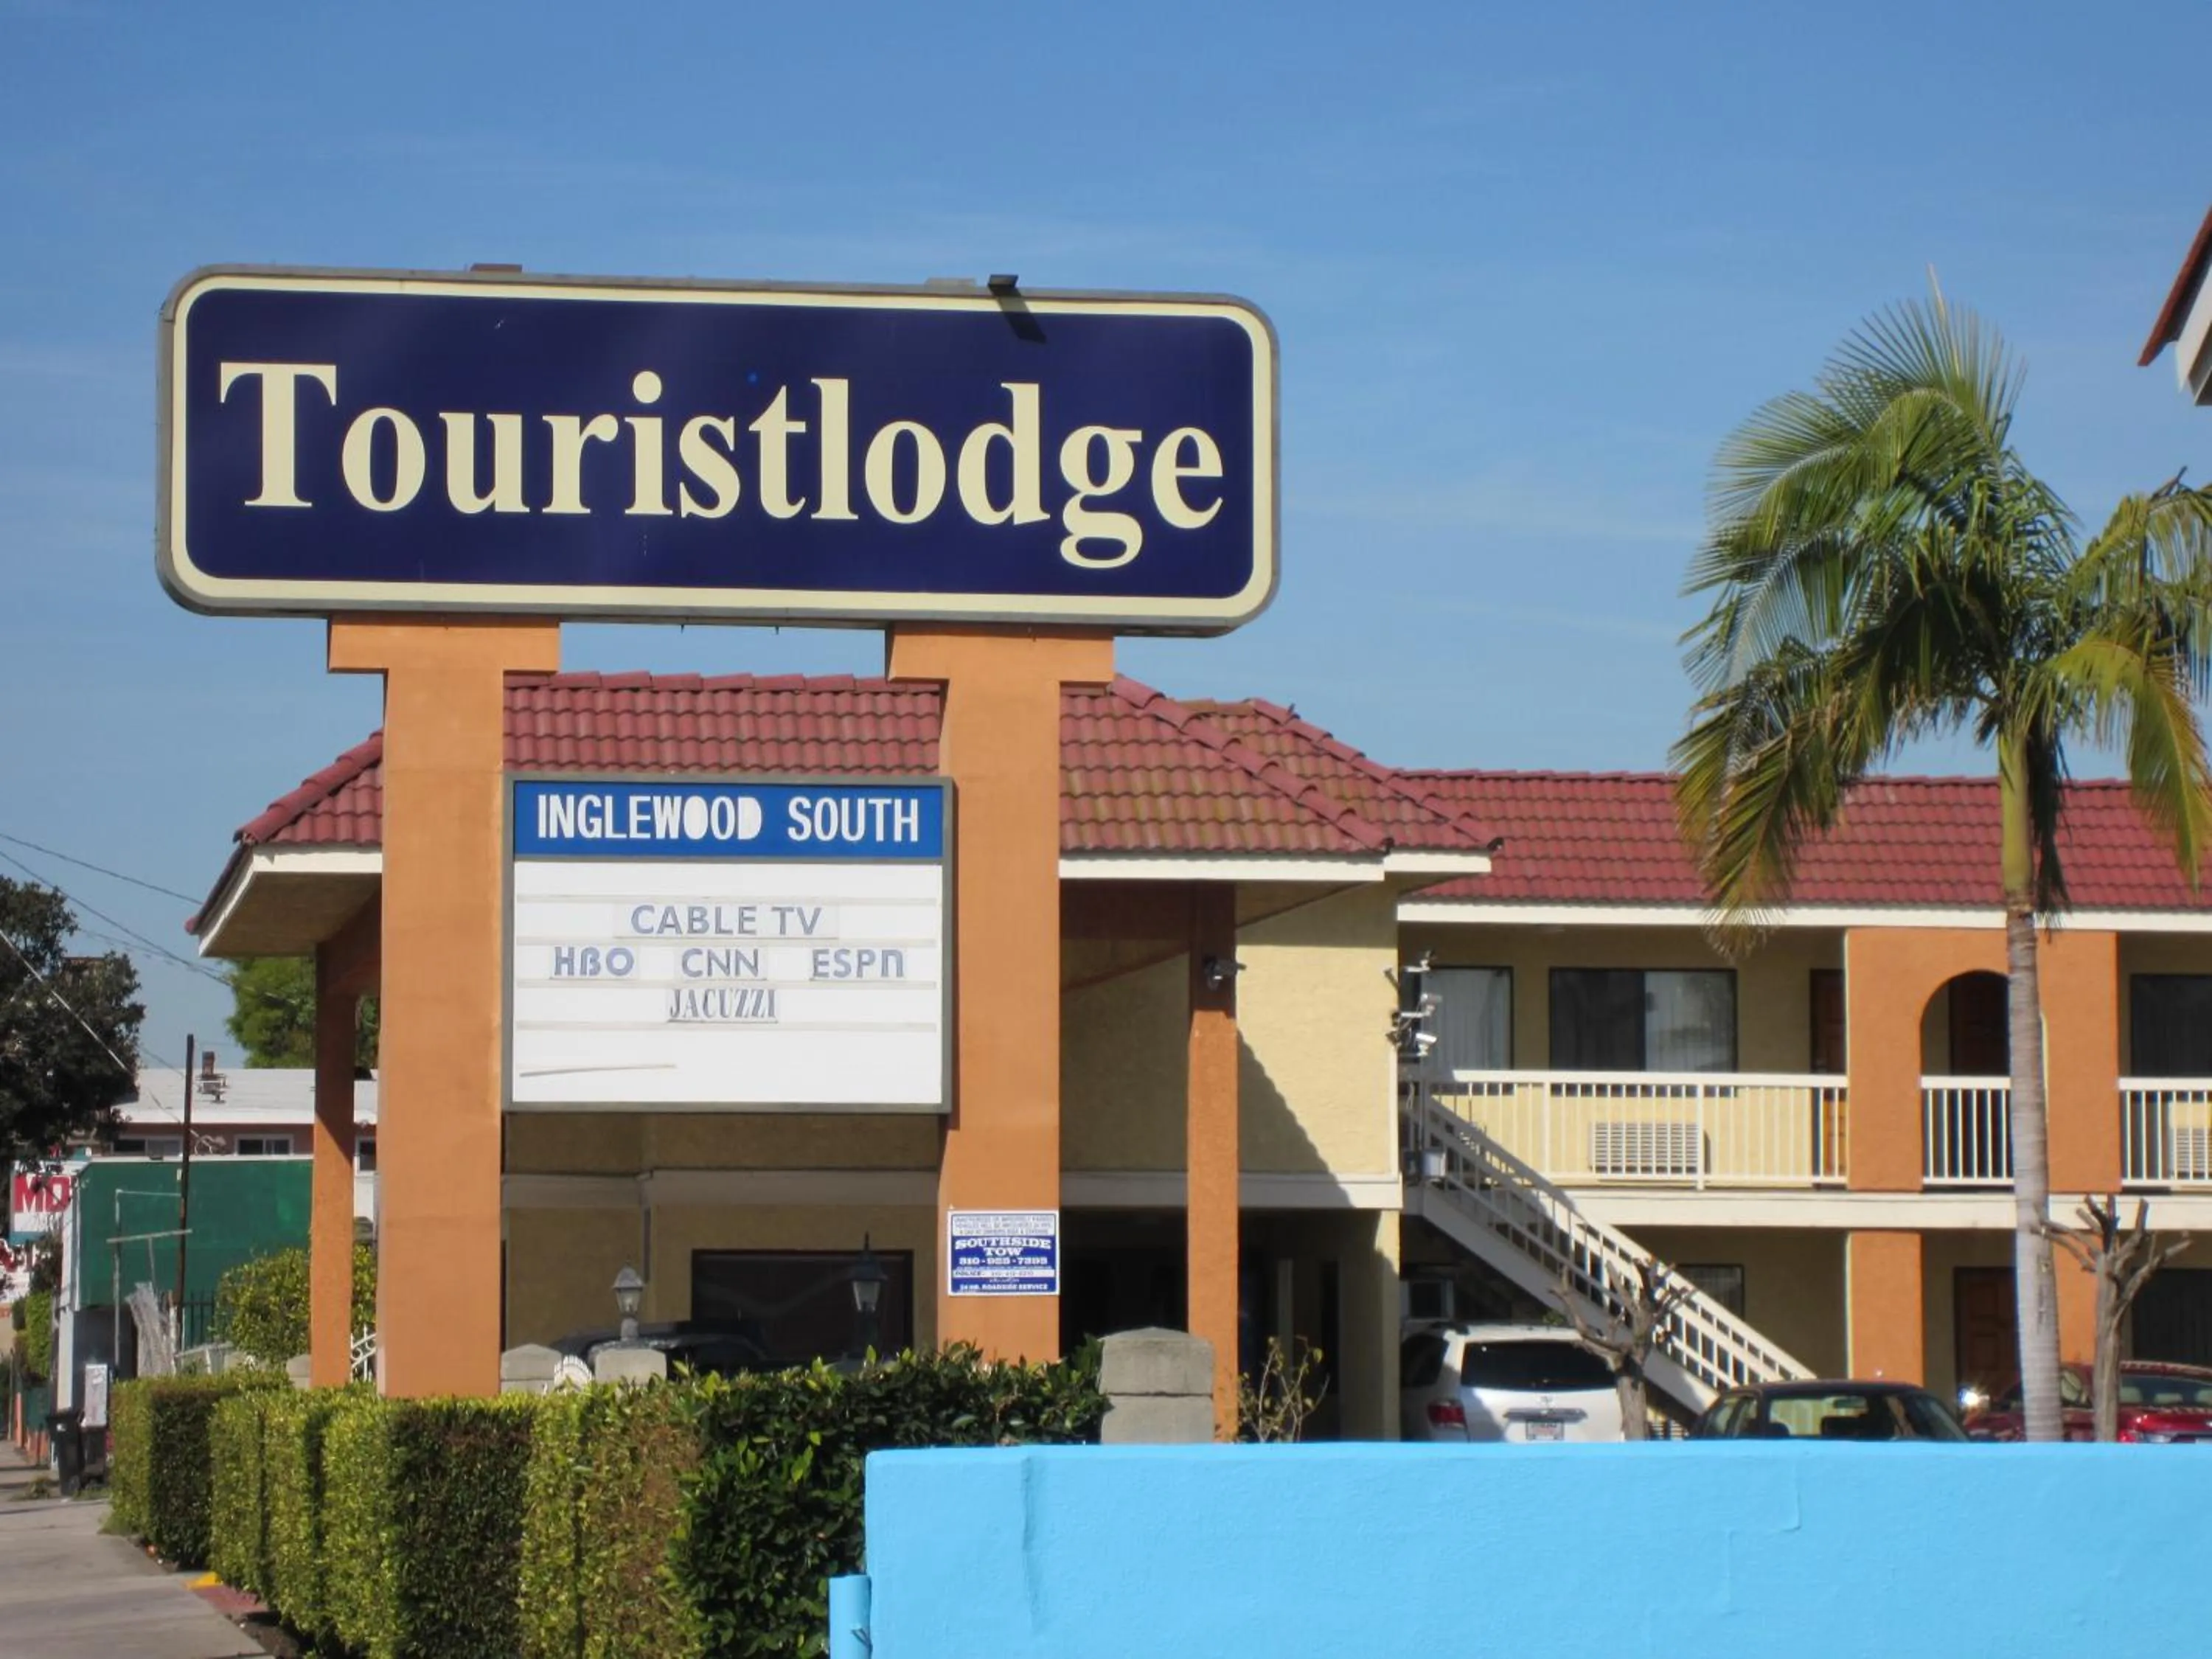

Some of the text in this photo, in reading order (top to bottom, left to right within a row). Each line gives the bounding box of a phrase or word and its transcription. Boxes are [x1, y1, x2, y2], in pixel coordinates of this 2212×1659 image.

[219, 362, 1224, 569] Touristlodge
[538, 793, 919, 843] INGLEWOOD SOUTH
[630, 904, 822, 936] CABLE TV
[554, 945, 635, 978] HBO
[681, 947, 760, 978] CNN
[669, 987, 777, 1020] JACUZZI
[955, 1237, 1051, 1250] SOUTHSIDE
[983, 1248, 1023, 1256] TOW
